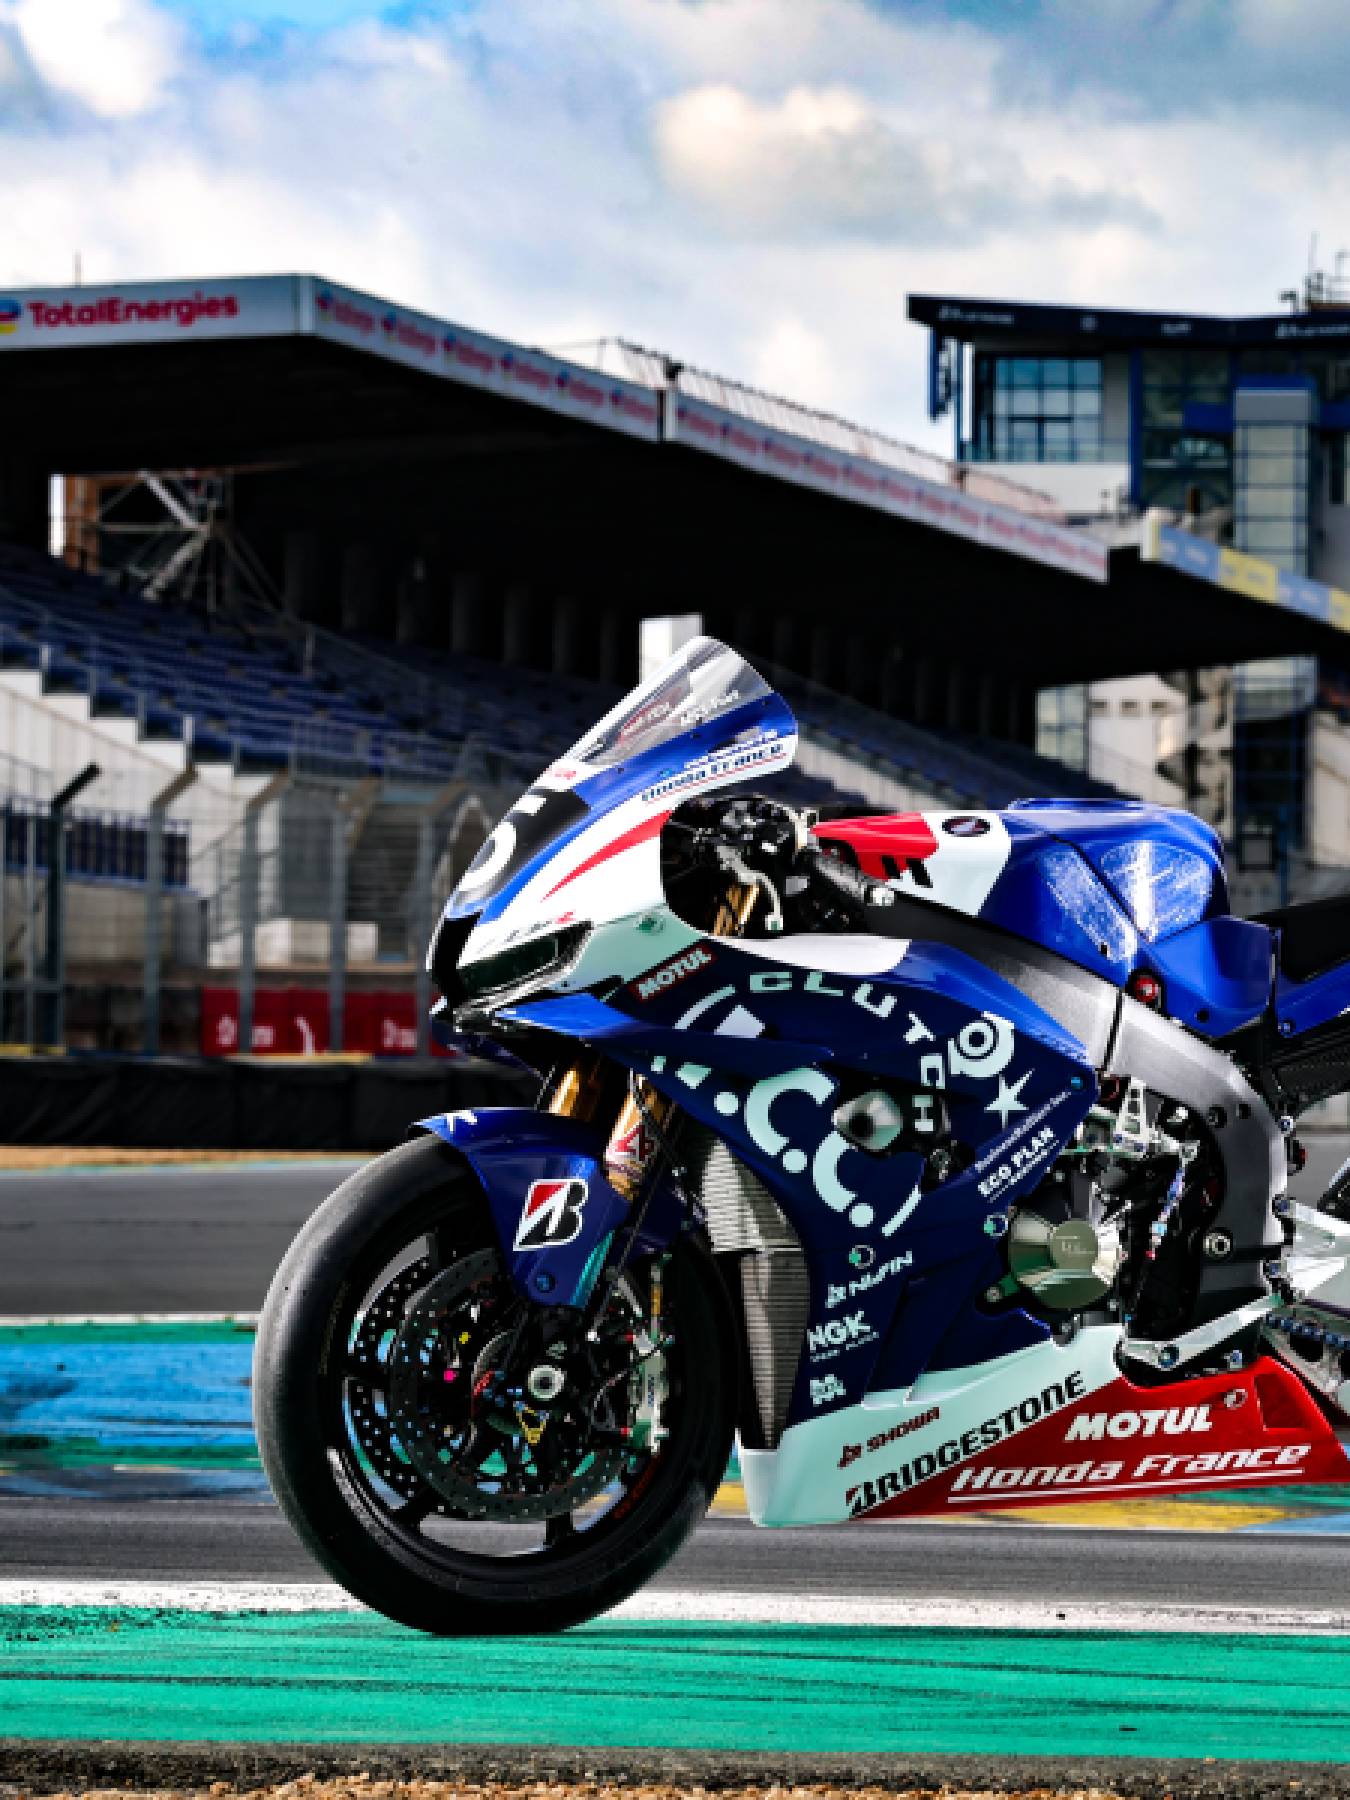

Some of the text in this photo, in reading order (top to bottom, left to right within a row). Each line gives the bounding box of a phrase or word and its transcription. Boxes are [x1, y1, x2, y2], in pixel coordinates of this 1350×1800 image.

[28, 291, 240, 328] TotalEnergies
[636, 950, 712, 1000] MOTUL
[978, 1164, 1011, 1196] ECO
[1012, 1126, 1055, 1167] PLAN
[807, 1311, 871, 1351] NGK
[846, 1371, 1084, 1519] BRIDGESTONE
[866, 1407, 940, 1452] SHOWA
[1063, 1406, 1212, 1442] MOTUL
[950, 1444, 1311, 1492] Honda France
